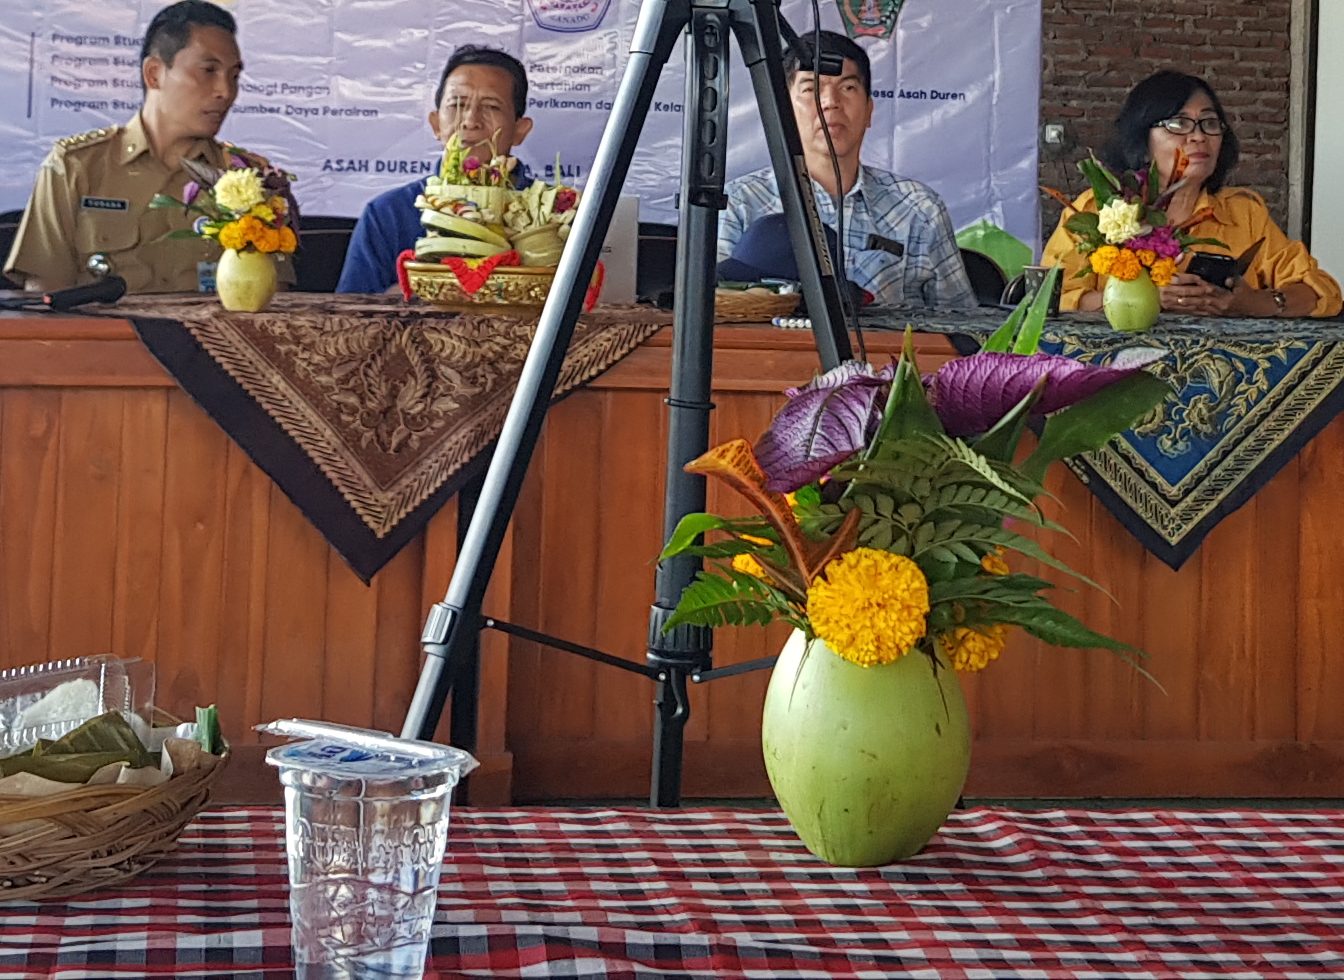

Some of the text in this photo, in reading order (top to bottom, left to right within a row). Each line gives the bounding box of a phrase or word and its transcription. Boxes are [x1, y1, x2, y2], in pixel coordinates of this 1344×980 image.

[897, 89, 927, 100] Asah
[930, 90, 966, 101] Duren
[529, 98, 592, 111] Perikanan
[285, 105, 319, 118] Daya
[323, 106, 379, 117] Perairan
[323, 158, 369, 172] ASAH
[375, 160, 431, 174] DUREN
